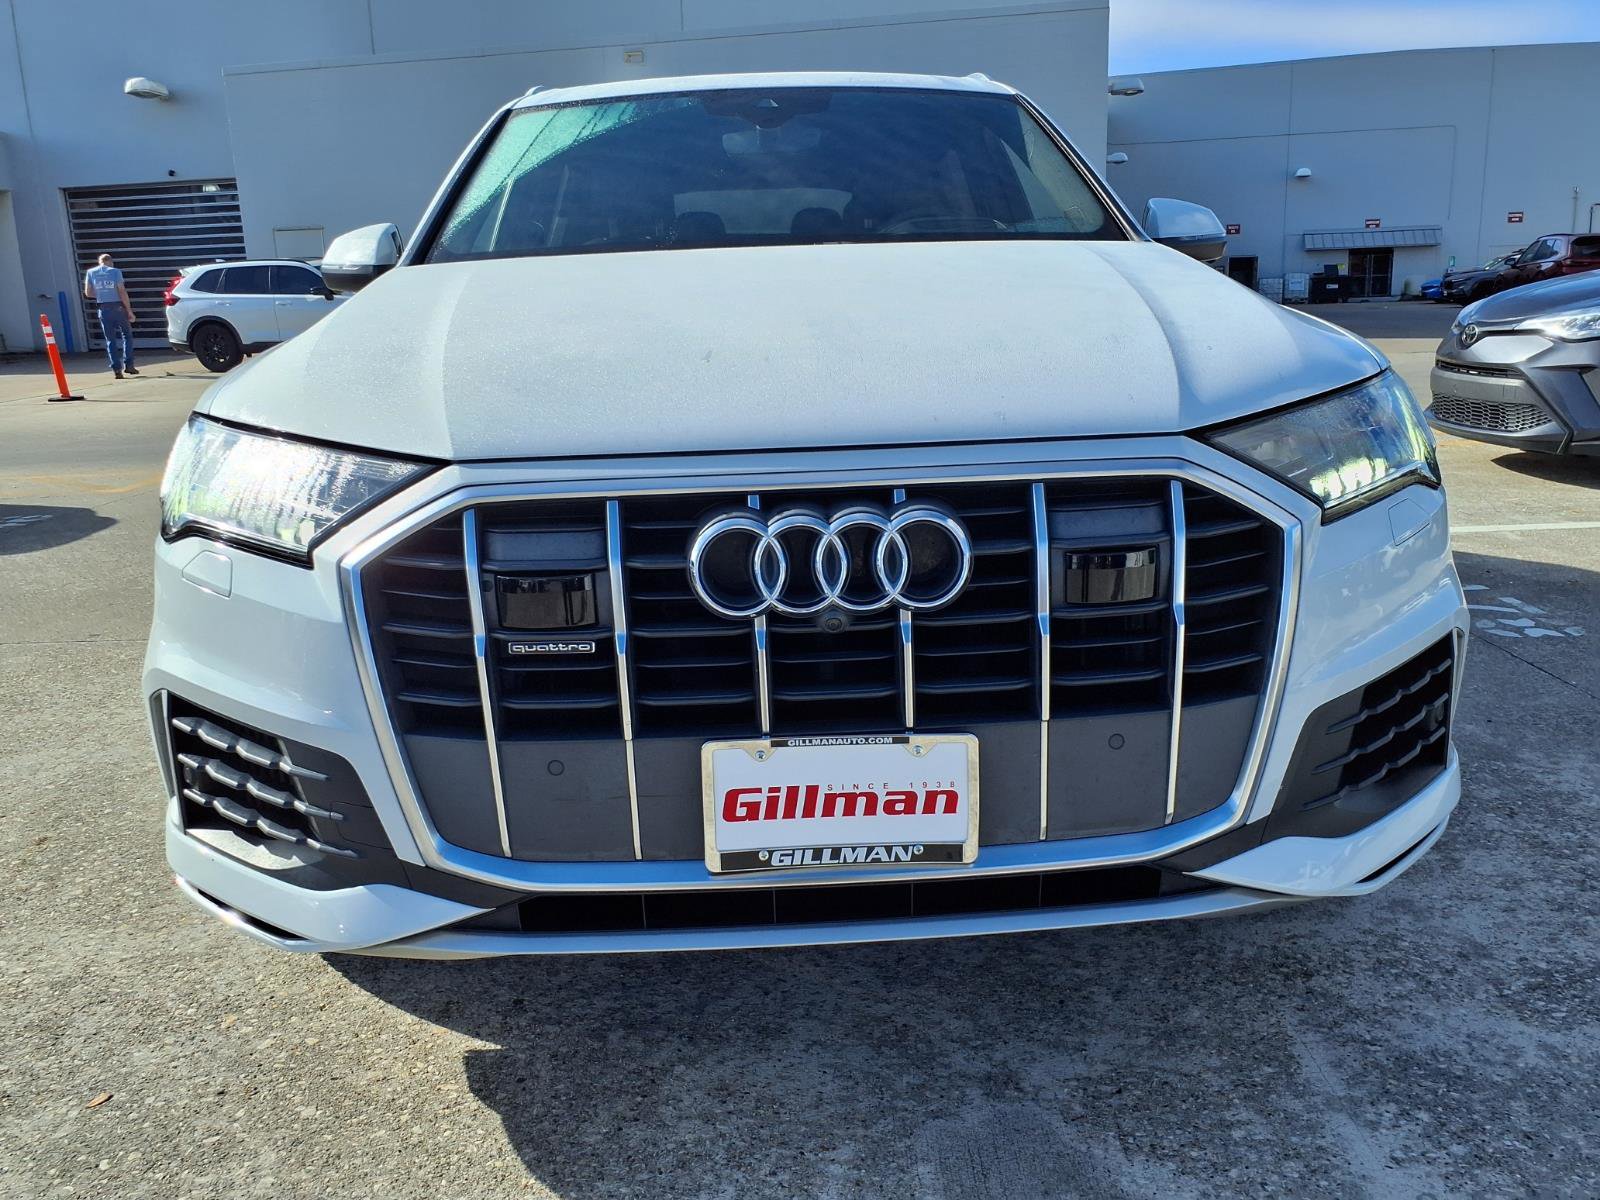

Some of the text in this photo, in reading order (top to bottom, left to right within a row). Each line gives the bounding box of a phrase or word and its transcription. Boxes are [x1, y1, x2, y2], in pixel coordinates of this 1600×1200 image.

[512, 643, 591, 653] quattro
[787, 737, 893, 746] GILLMANAUTO.COM
[827, 781, 955, 791] SINCE 1938
[722, 785, 959, 822] Gillman
[770, 846, 914, 866] GILLMAN
